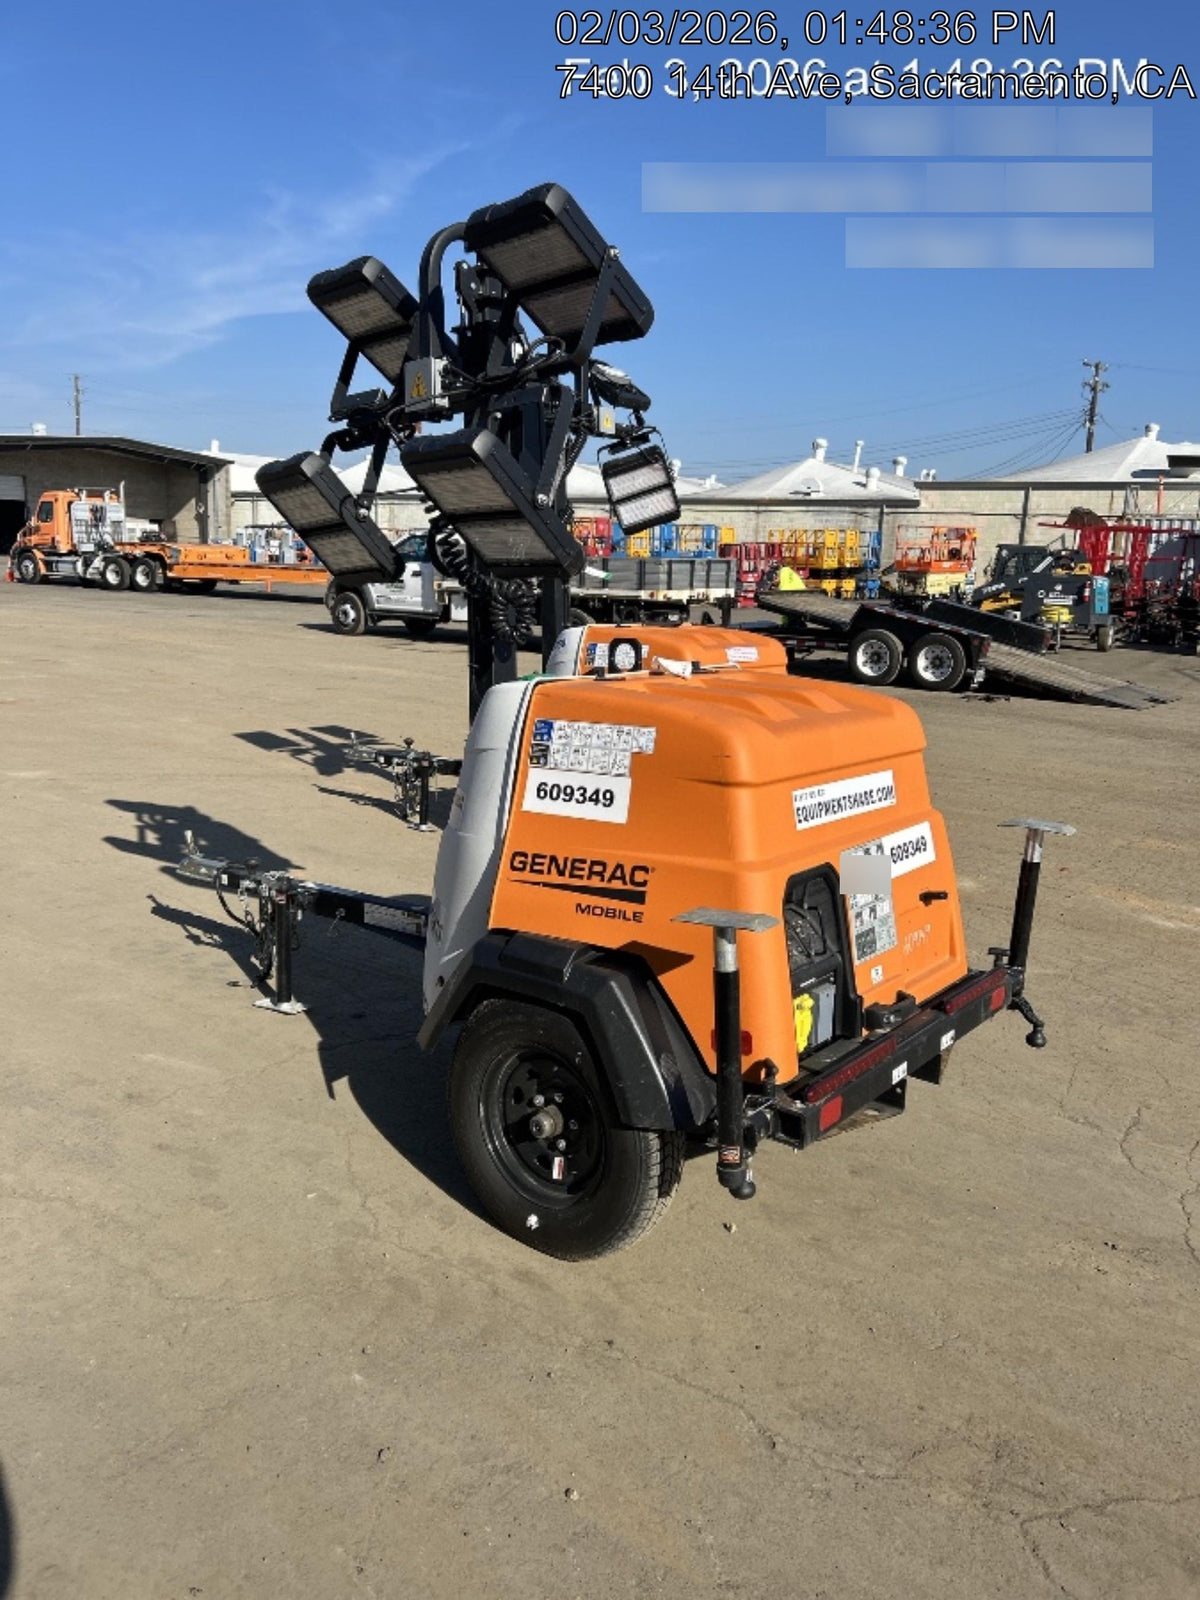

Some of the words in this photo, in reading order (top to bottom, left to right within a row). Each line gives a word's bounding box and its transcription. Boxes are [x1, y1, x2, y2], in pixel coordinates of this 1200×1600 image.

[536, 781, 614, 808] 609349
[890, 835, 927, 864] 609349
[509, 851, 650, 888] GENERAC
[575, 902, 644, 923] MOBILE
